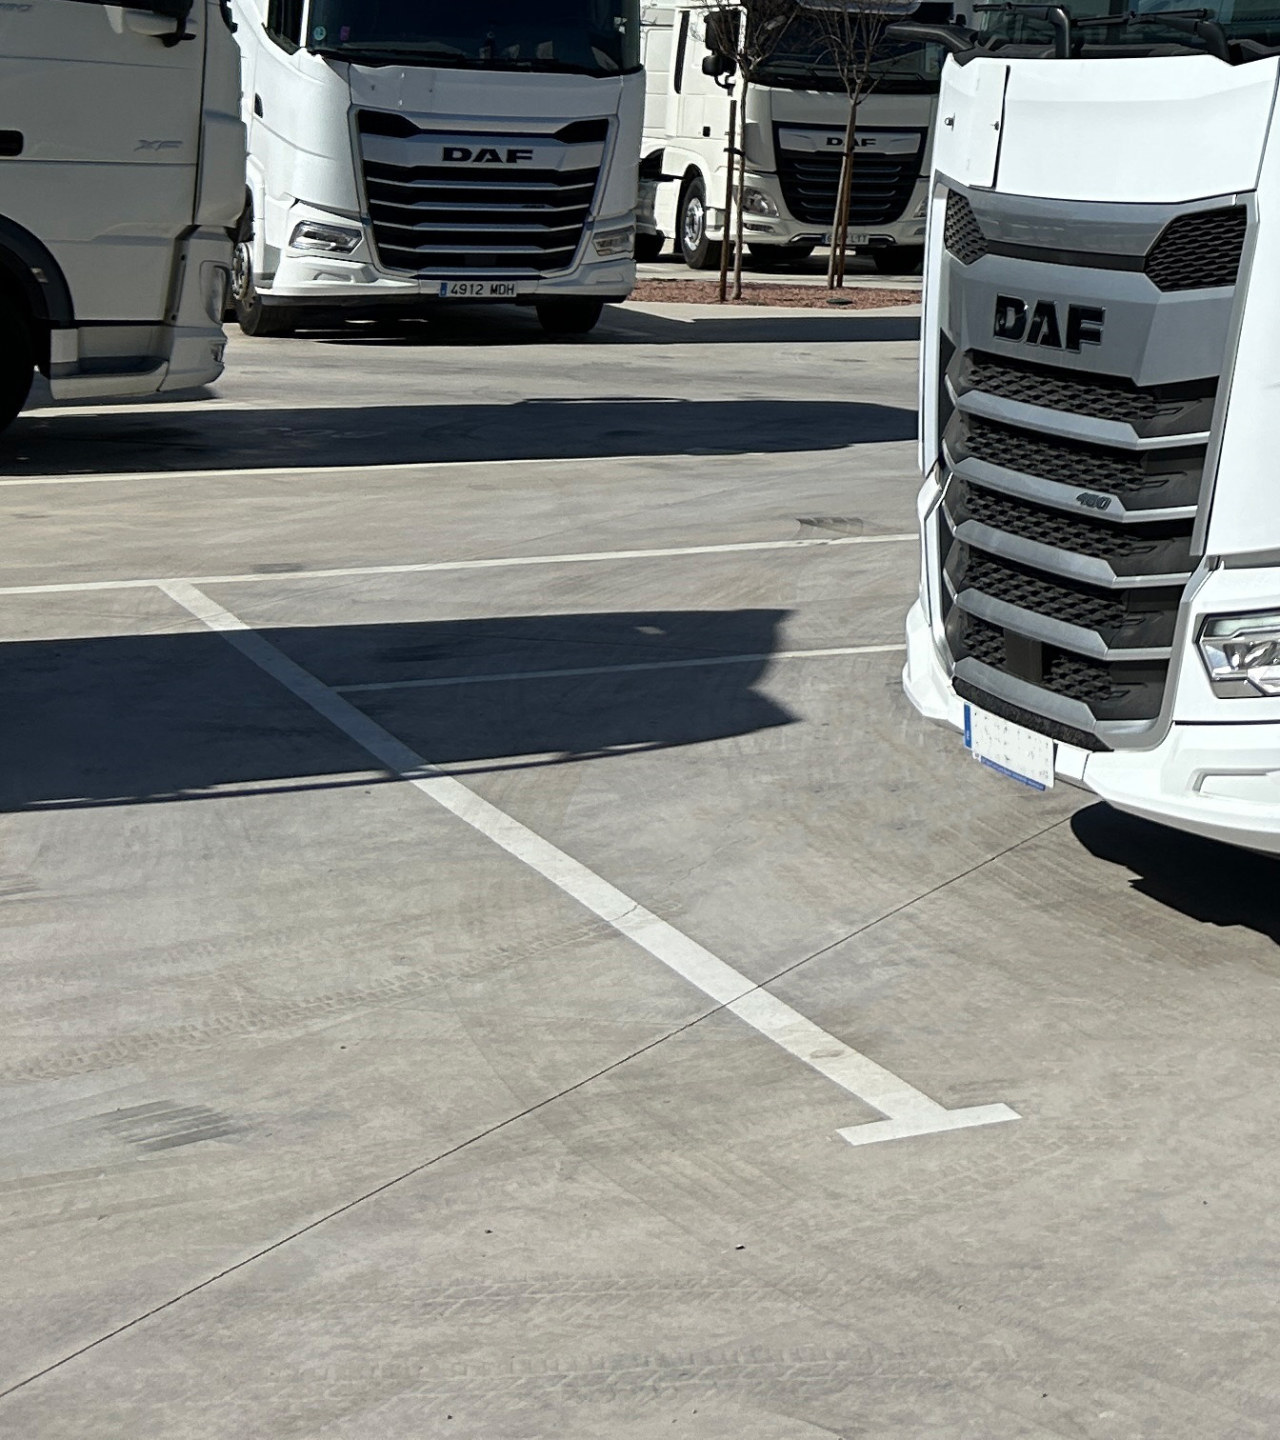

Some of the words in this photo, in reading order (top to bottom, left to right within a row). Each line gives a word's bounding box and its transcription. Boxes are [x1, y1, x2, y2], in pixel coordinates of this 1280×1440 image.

[442, 146, 534, 164] DAF
[450, 283, 484, 296] 4912
[489, 283, 516, 297] MDH
[992, 292, 1106, 354] DAF
